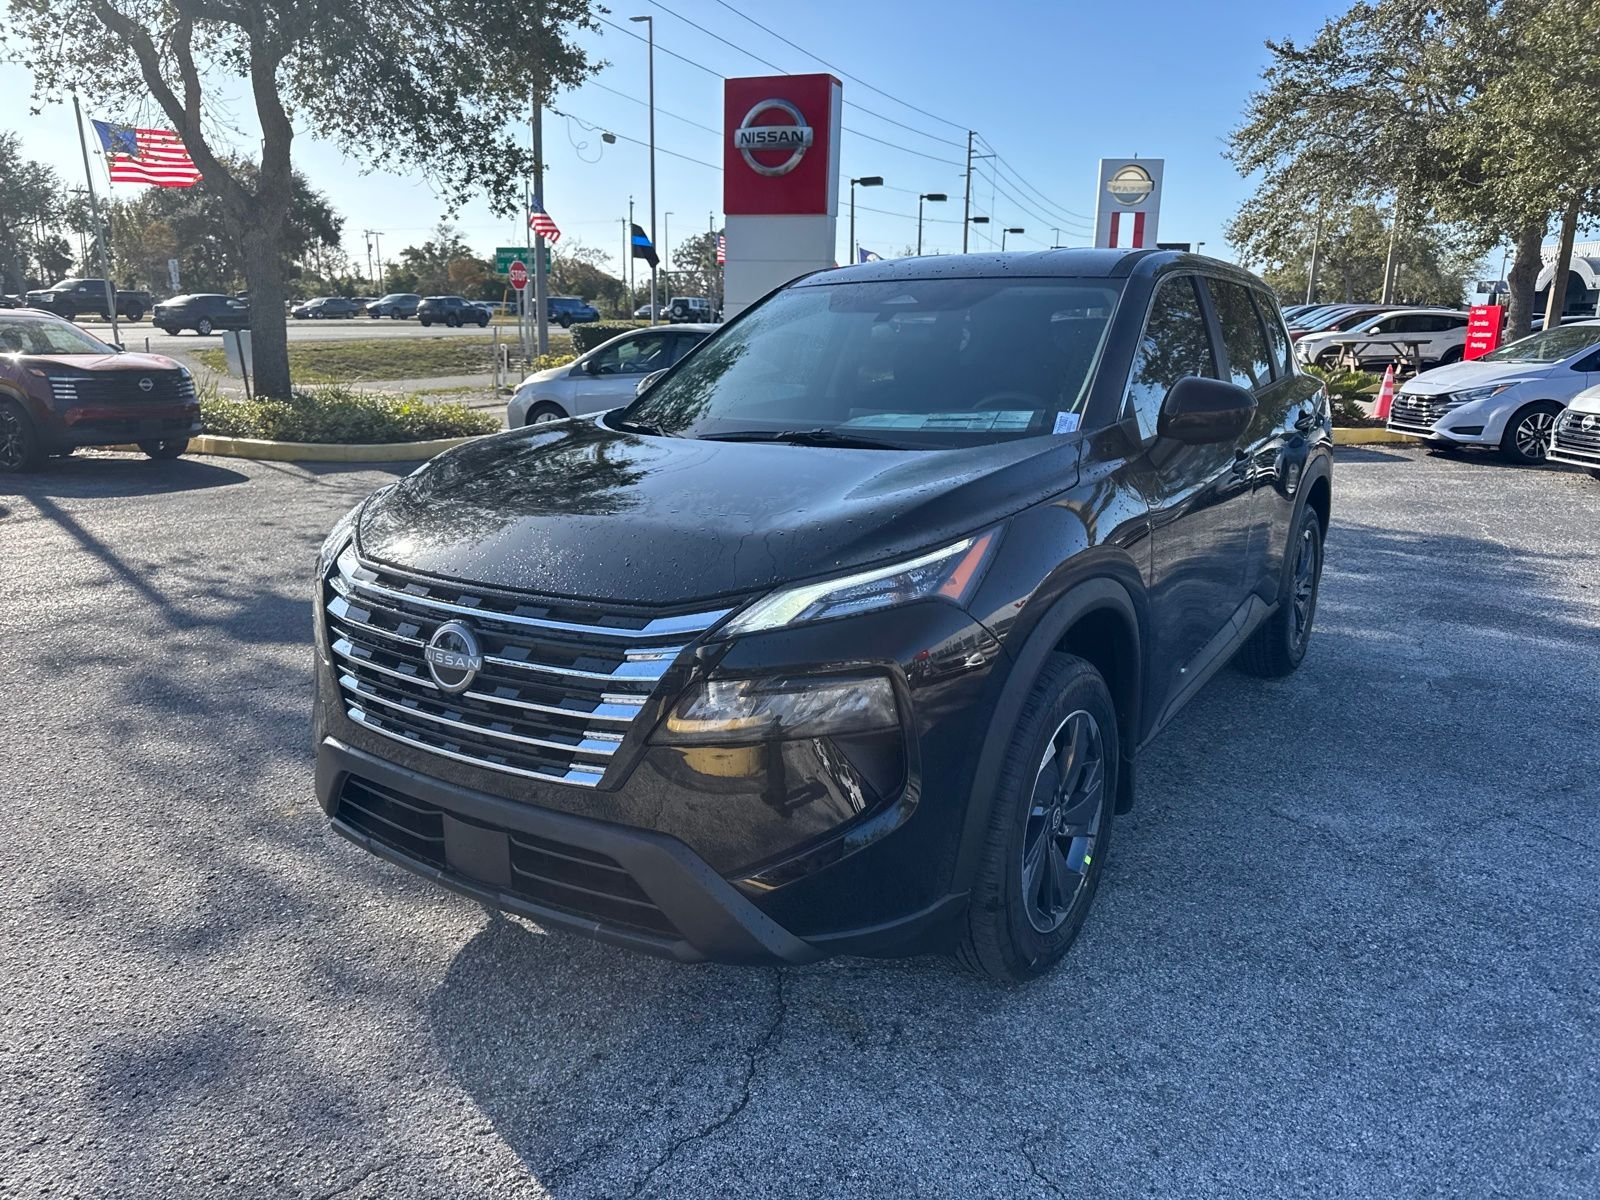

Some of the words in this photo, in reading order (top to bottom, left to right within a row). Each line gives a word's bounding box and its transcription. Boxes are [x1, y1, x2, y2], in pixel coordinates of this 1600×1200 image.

[740, 131, 804, 144] NISSAN
[511, 270, 527, 281] STOP
[425, 648, 479, 669] NISSAN
